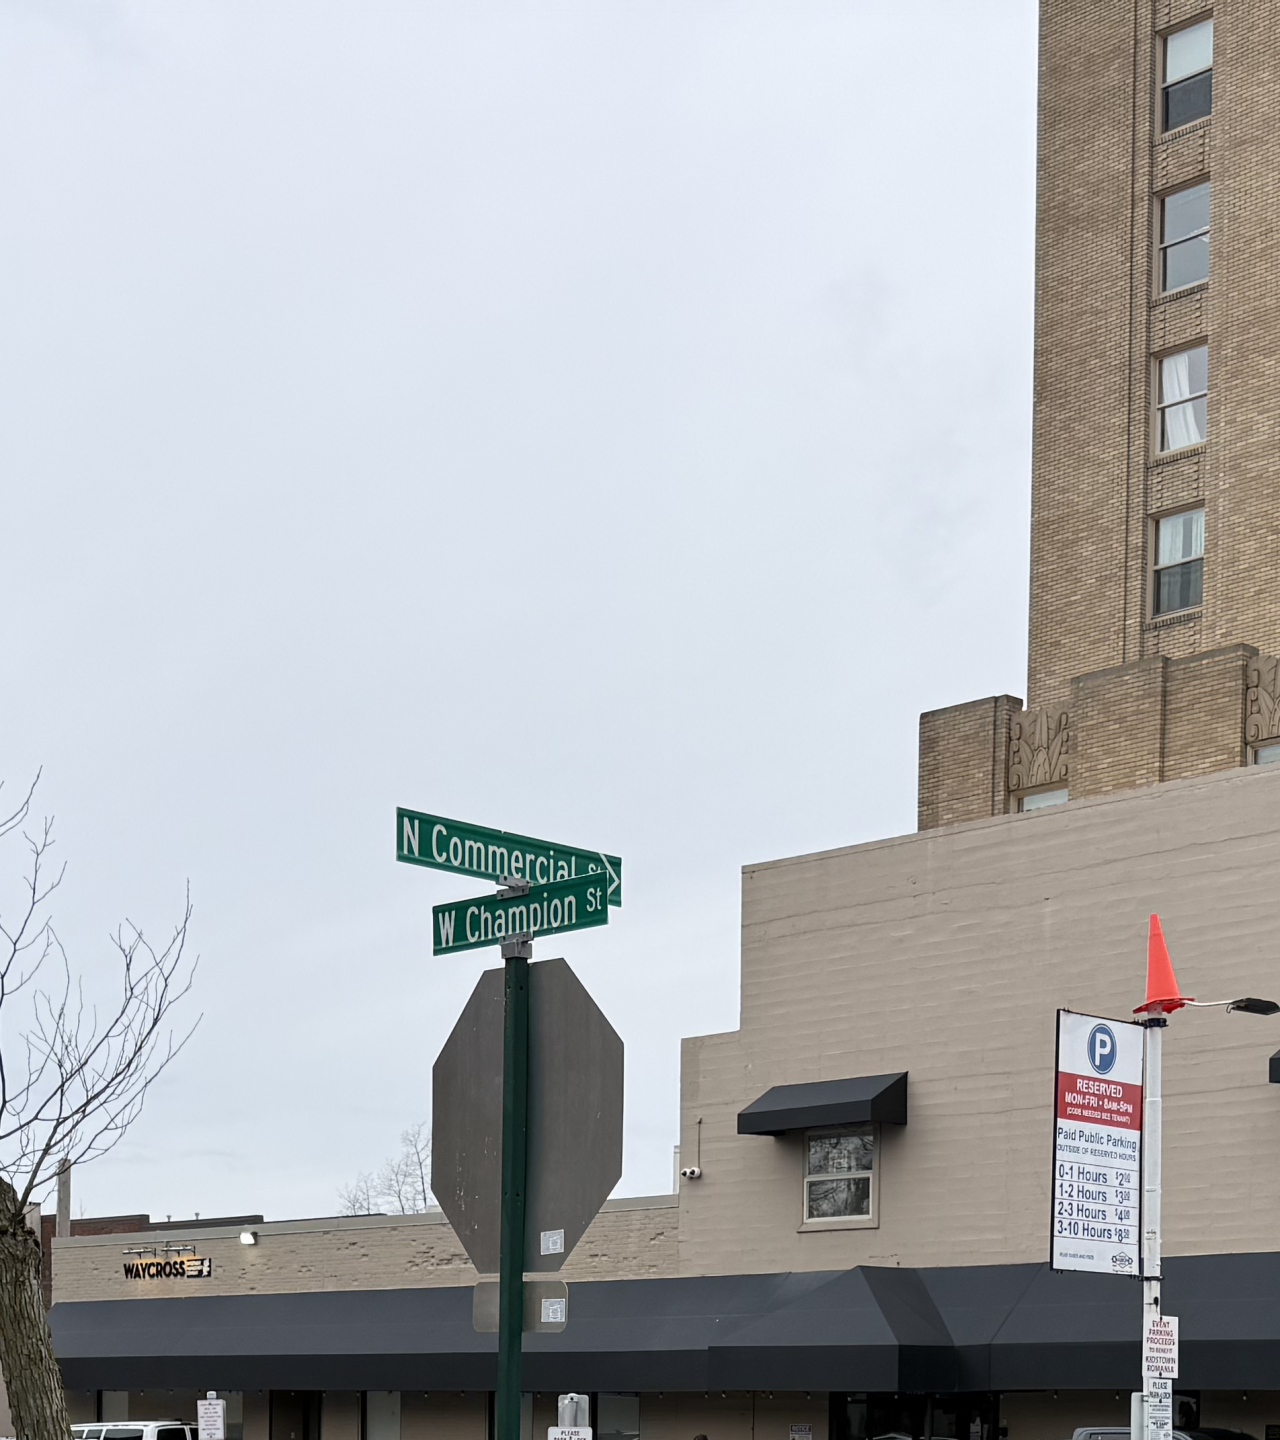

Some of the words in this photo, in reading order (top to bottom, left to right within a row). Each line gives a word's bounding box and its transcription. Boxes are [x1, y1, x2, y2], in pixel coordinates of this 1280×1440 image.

[403, 817, 419, 857] N
[432, 824, 575, 884] Commercial
[438, 910, 456, 948] W
[466, 892, 576, 943] Champion
[586, 887, 602, 912] St
[1095, 1032, 1112, 1066] P
[1076, 1078, 1123, 1098] RESERVED
[1065, 1092, 1098, 1107] MON-FRI
[1104, 1098, 1133, 1113] 8AM-5PM
[1058, 1127, 1076, 1141] Paid
[1079, 1130, 1105, 1145] Public
[1106, 1134, 1137, 1153] Parking
[1057, 1144, 1080, 1154] OUTSIDE
[1090, 1148, 1118, 1160] RESERVED
[1119, 1153, 1136, 1162] HOURS
[1059, 1163, 1074, 1179] 0-1
[1078, 1166, 1108, 1184] Hours
[1059, 1182, 1074, 1198] 1-2
[1077, 1185, 1107, 1202] Hours
[1058, 1201, 1074, 1217] 2-3
[1077, 1203, 1107, 1221] Hours
[1057, 1220, 1079, 1236] 3-10
[1082, 1222, 1112, 1239] Hours
[123, 1260, 186, 1280] WAYCROSS
[1149, 1329, 1173, 1337] PARKING
[1152, 1320, 1170, 1328] EVENT
[1146, 1337, 1175, 1346] PROCEEDS
[1153, 1381, 1168, 1389] PLEASE
